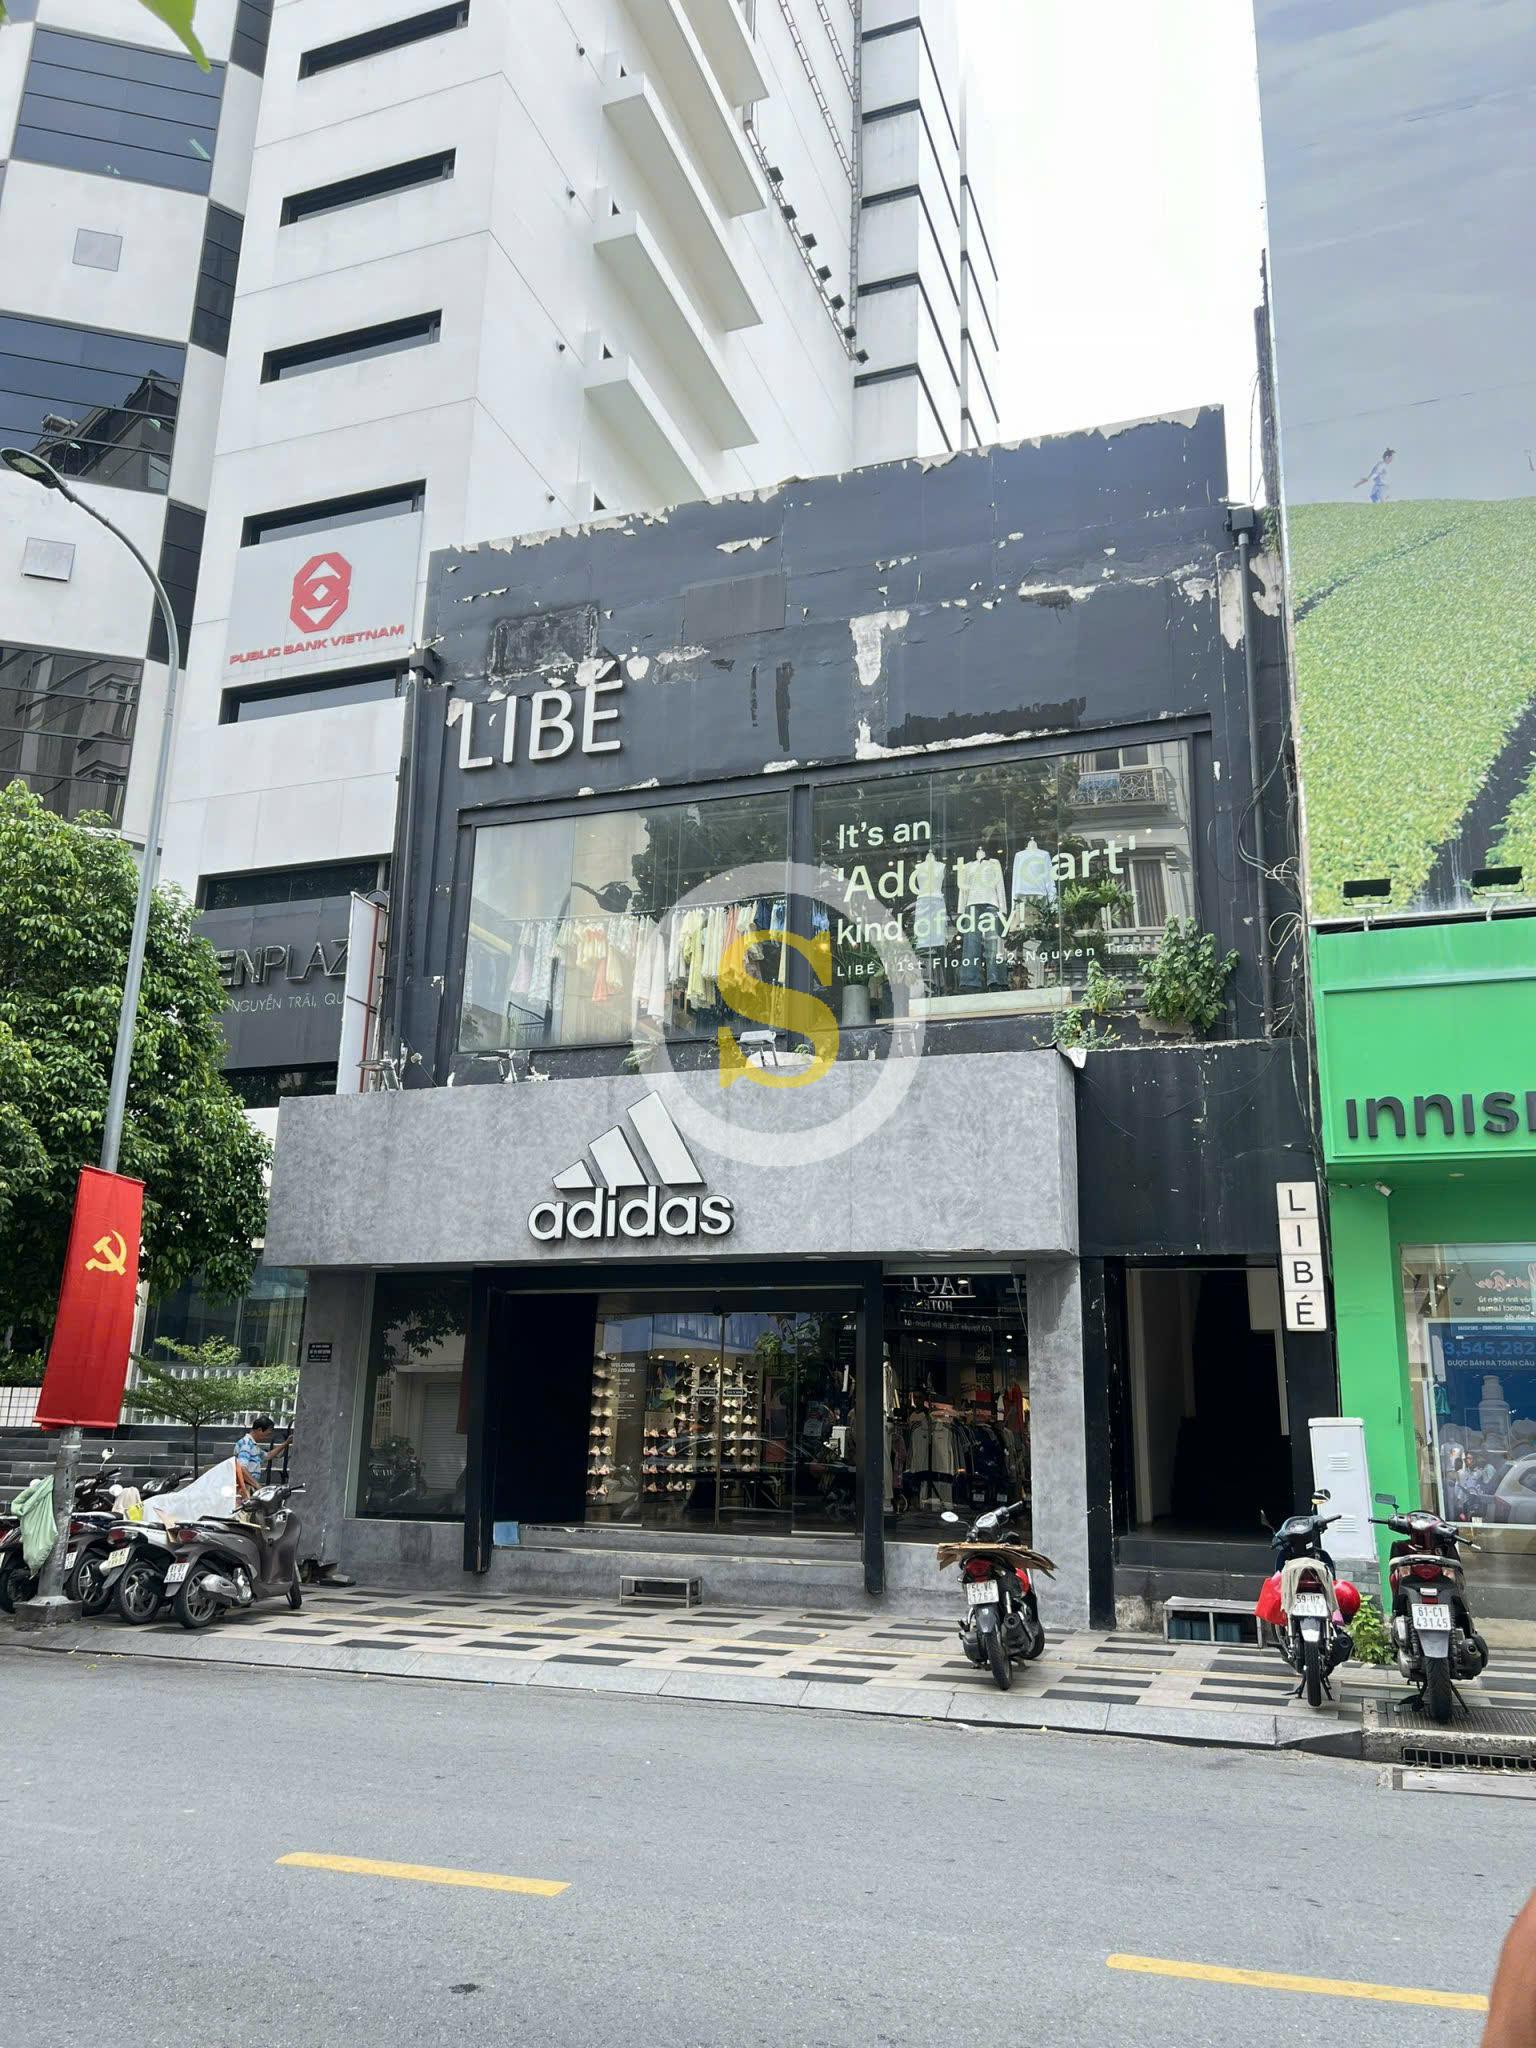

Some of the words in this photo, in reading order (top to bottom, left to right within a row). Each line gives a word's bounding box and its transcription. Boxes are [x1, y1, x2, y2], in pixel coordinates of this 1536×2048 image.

[229, 647, 280, 665] PUBLIC
[283, 638, 328, 655] BANK
[330, 624, 405, 645] VIETNAM
[458, 660, 624, 769] LIBÉ
[838, 821, 883, 850] It's
[893, 820, 931, 844] an
[952, 856, 1001, 890] to
[836, 914, 903, 946] kind
[914, 911, 946, 938] of
[955, 900, 1026, 937] day!
[836, 961, 876, 977] LIBÉ
[896, 961, 923, 972] 1st
[932, 956, 986, 969] Floor,
[1025, 946, 1095, 963] Nguyen
[1105, 942, 1143, 955] Trai
[527, 1184, 735, 1241] adidas
[1287, 1188, 1316, 1326] LIBÉ
[1417, 1606, 1443, 1616] 61-C1
